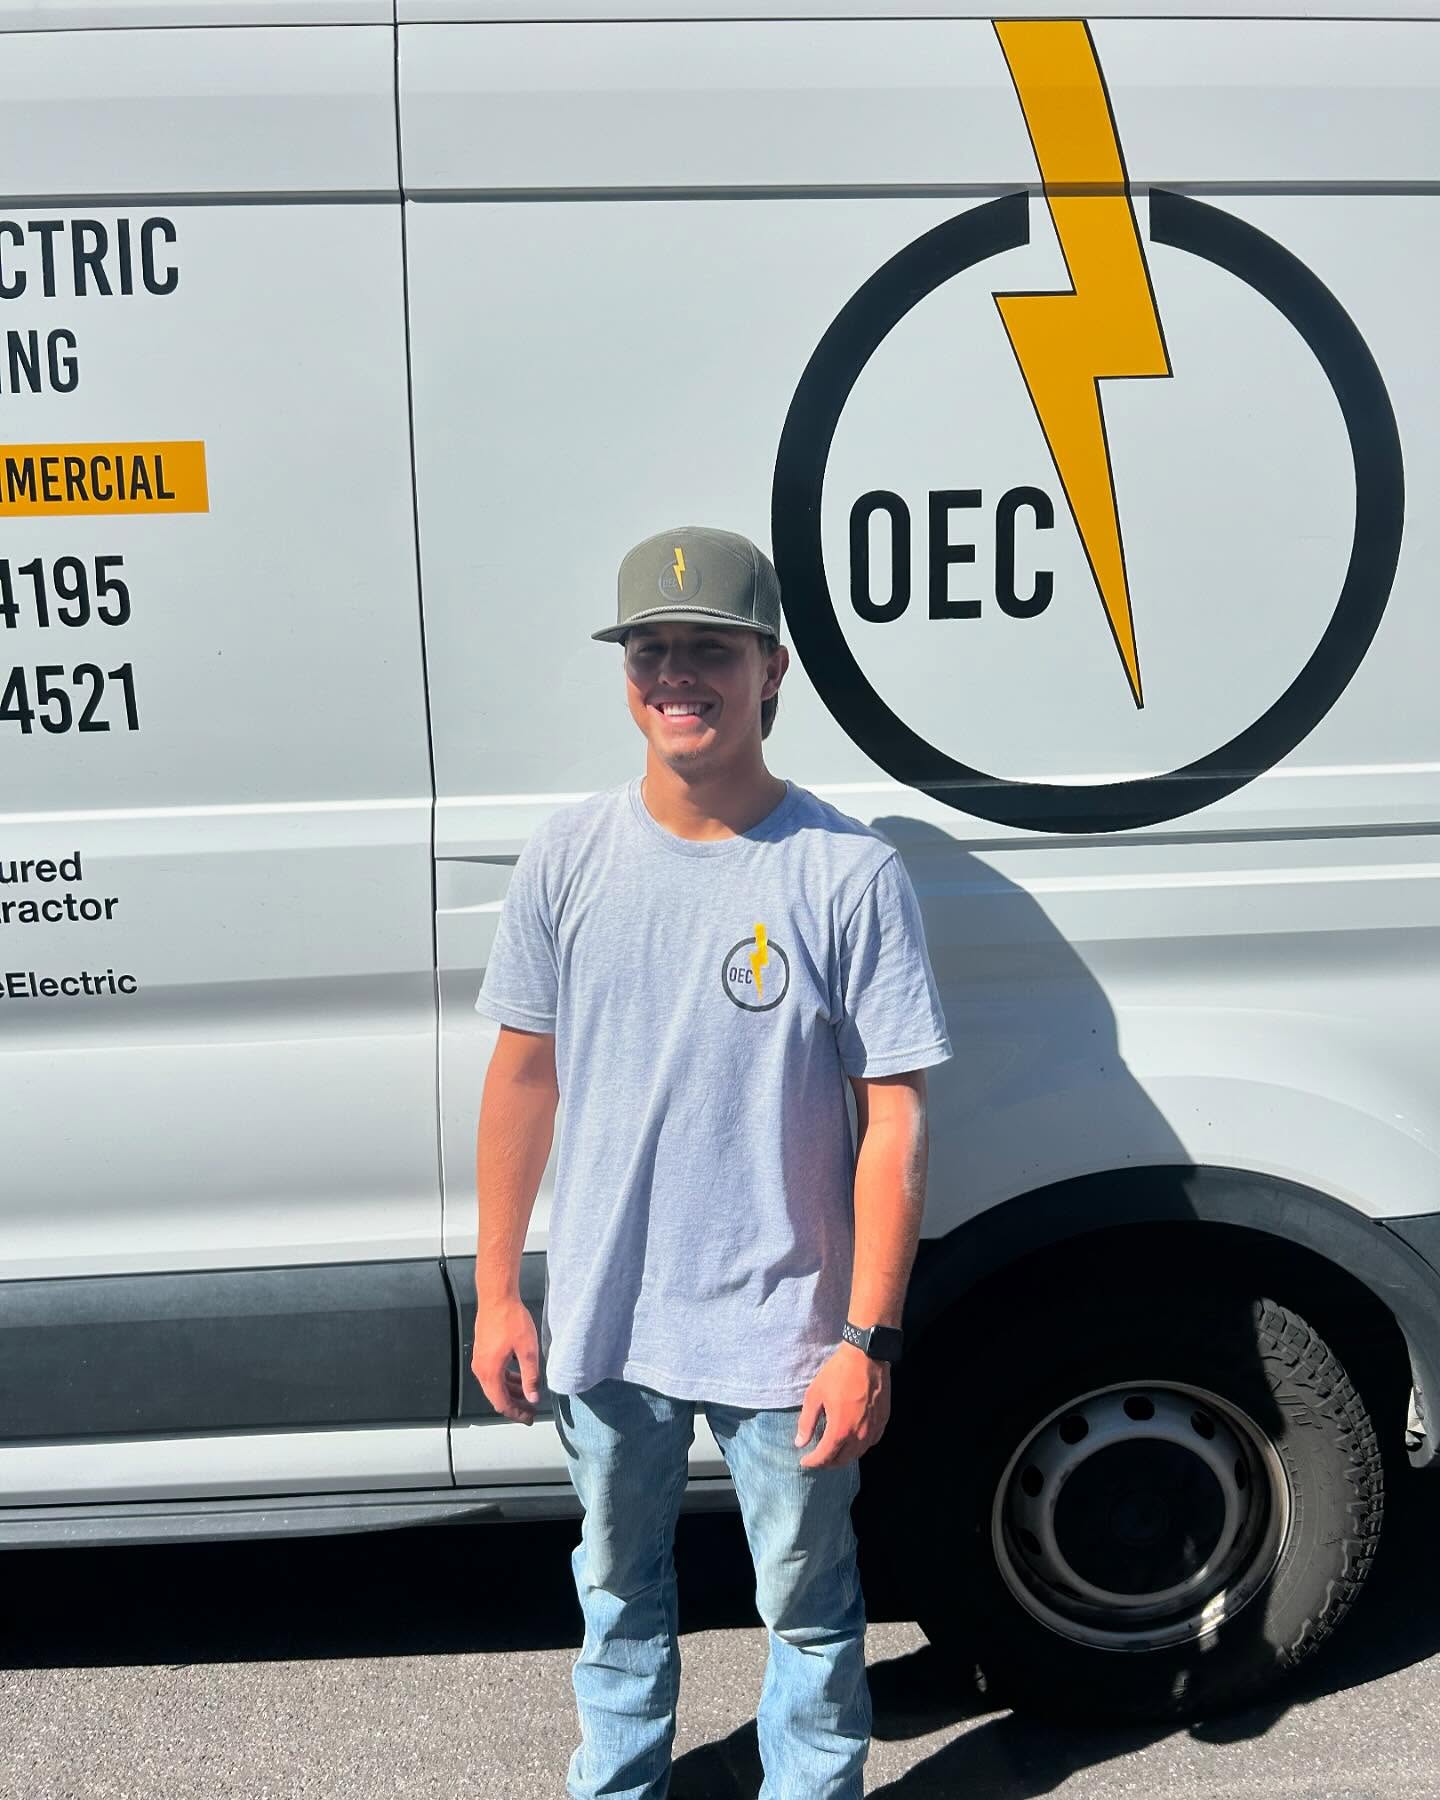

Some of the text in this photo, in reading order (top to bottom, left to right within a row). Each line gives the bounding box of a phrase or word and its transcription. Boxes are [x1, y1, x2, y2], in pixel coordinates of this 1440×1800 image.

[0, 217, 179, 299] CTRIC
[0, 328, 79, 394] NG
[0, 455, 175, 502] MERCIAL
[849, 486, 1055, 623] OEC
[0, 663, 140, 734] 4521
[0, 851, 82, 884] ured
[0, 893, 119, 924] ractor
[0, 969, 138, 998] Electric
[729, 966, 753, 985] OEC
